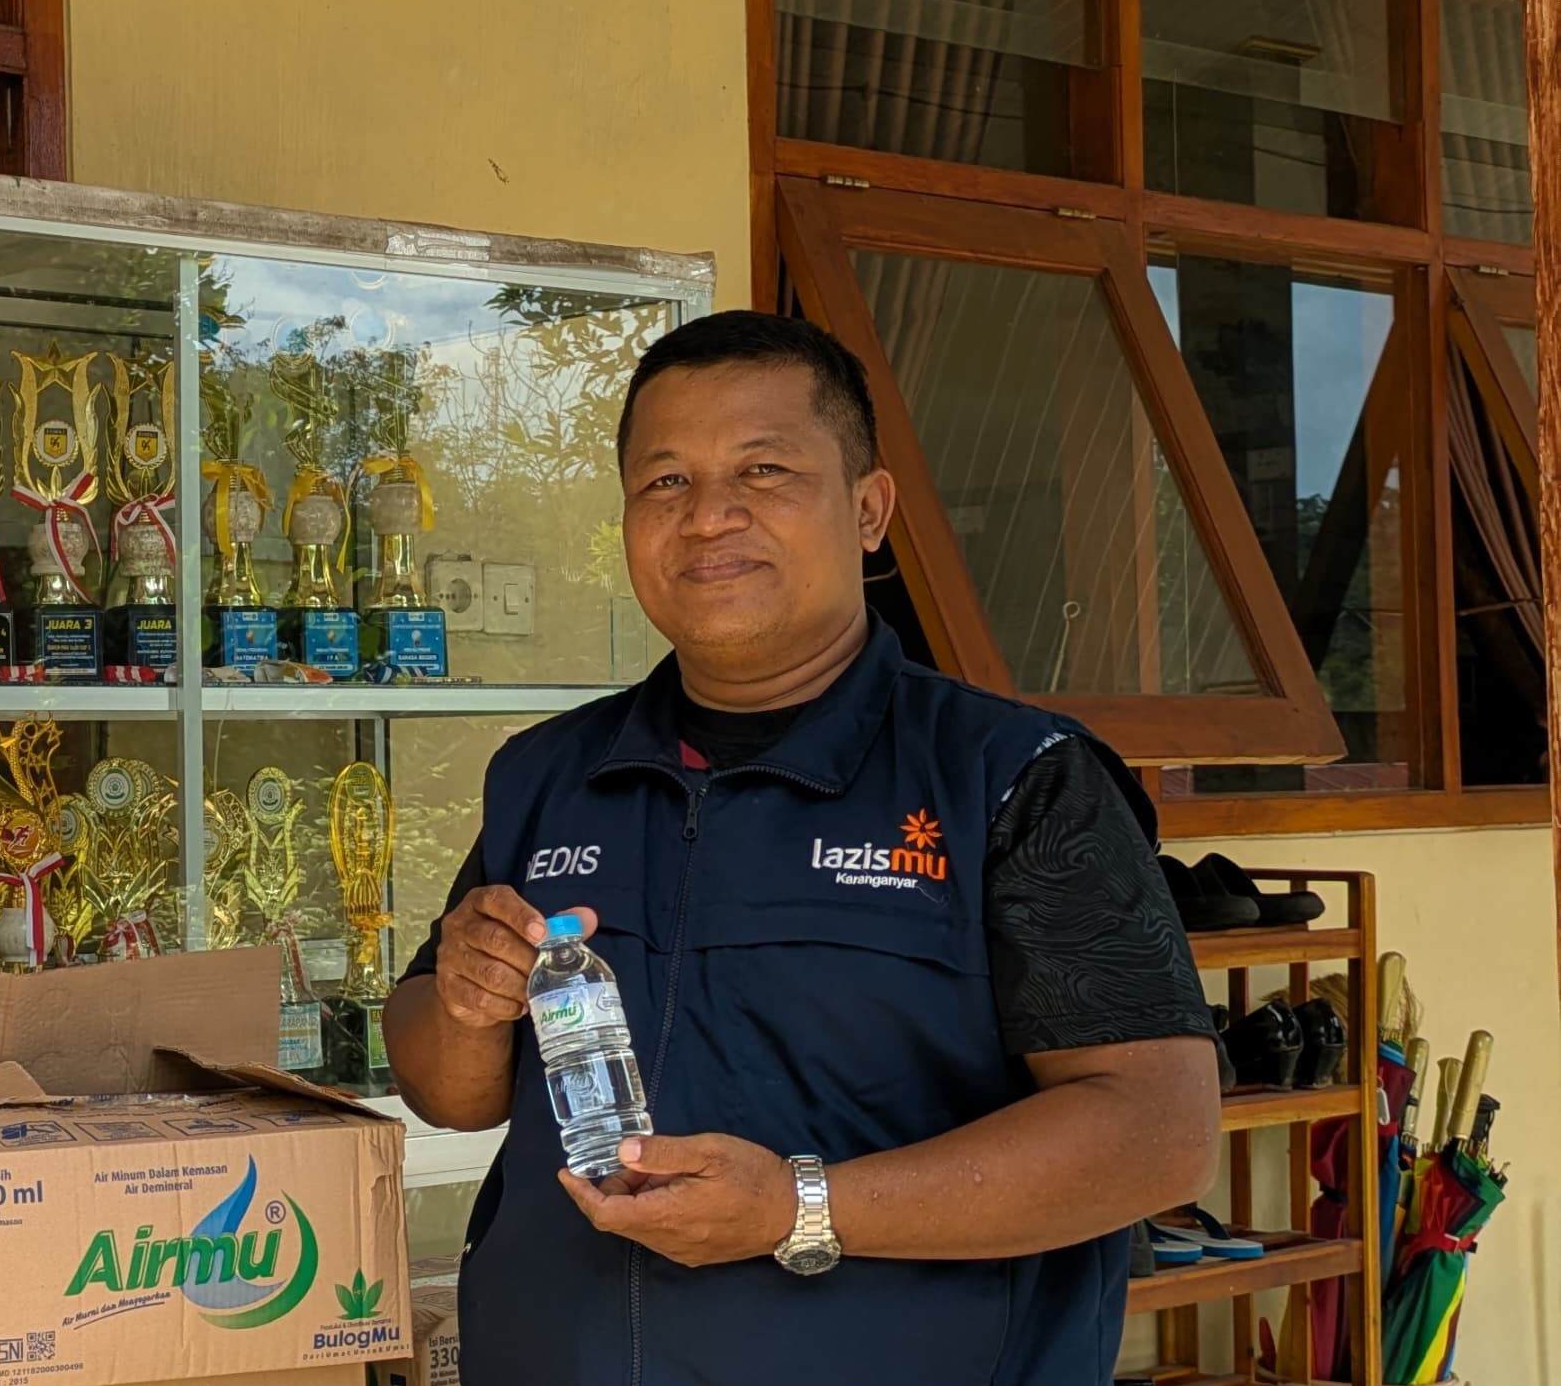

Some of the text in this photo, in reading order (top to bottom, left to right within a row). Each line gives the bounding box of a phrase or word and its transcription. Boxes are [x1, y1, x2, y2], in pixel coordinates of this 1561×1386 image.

[44, 619, 93, 630] JUARA 3
[136, 619, 172, 630] JUARA
[525, 845, 602, 882] EDIS
[811, 838, 948, 881] lazismu
[835, 871, 919, 889] Karanganyar
[540, 1004, 578, 1025] Airmu
[94, 1163, 228, 1182] Air Minum Dalam Kemasan
[13, 1179, 43, 1204] ml
[124, 1179, 192, 1194] Air Demineral
[62, 1225, 283, 1296] Airmu
[313, 1327, 399, 1348] BulogMu
